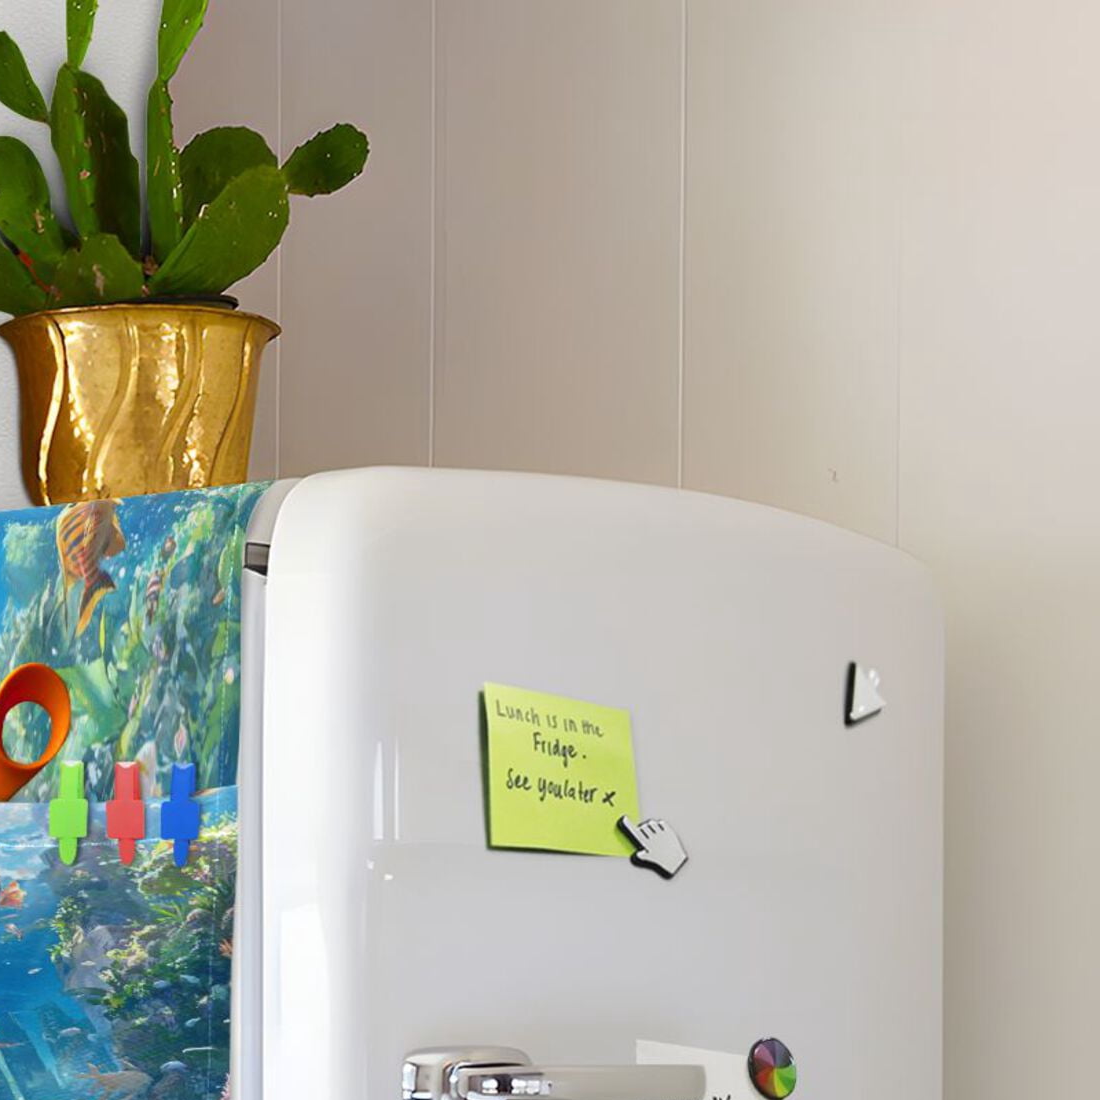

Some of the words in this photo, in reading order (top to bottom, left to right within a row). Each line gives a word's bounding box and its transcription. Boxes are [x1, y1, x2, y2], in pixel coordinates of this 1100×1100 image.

[496, 699, 540, 727] Lunch
[564, 718, 578, 733] in
[582, 719, 604, 738] the
[506, 768, 532, 791] See
